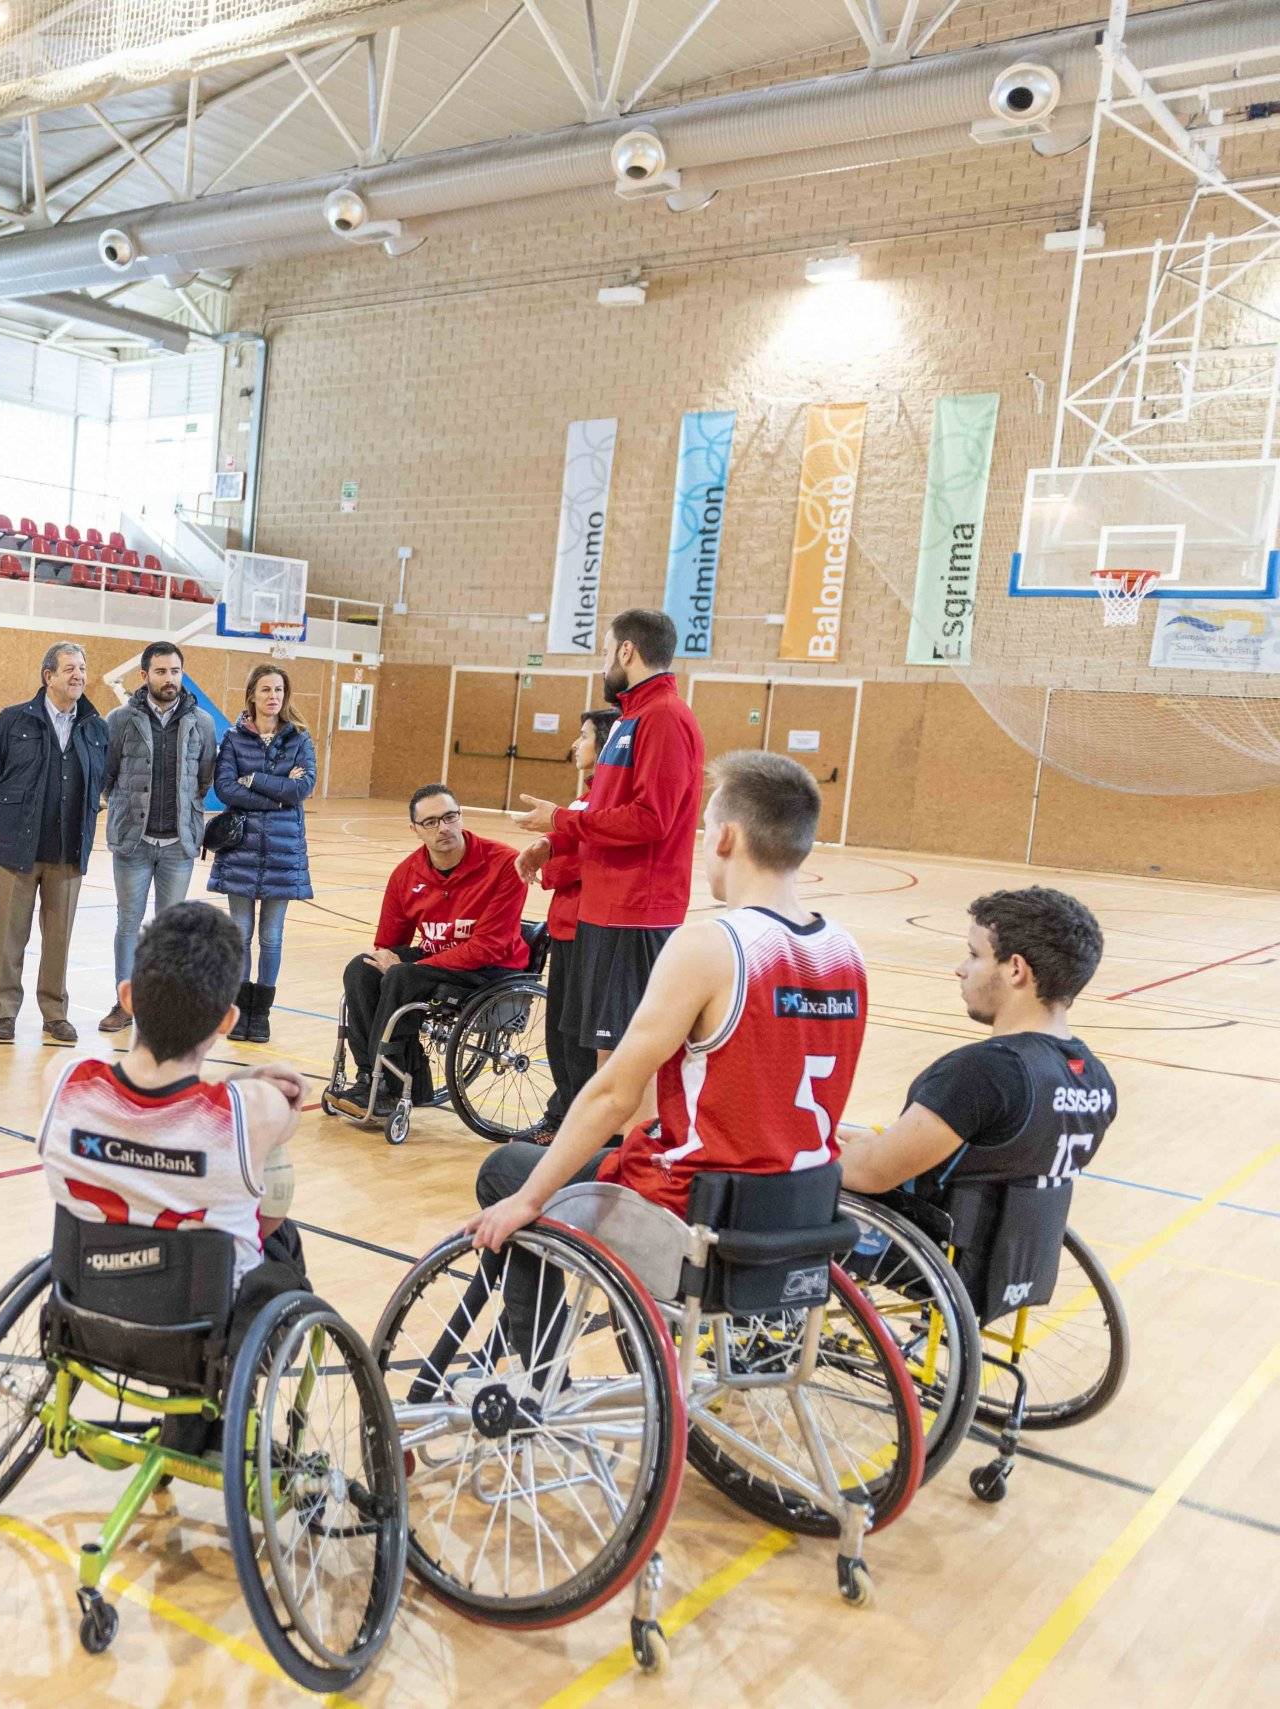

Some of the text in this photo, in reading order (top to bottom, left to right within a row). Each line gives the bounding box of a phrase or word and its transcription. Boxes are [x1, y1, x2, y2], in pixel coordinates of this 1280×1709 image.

[572, 511, 605, 650] Atletismo
[685, 486, 725, 653] Bádminton
[808, 474, 854, 656] Baloncesto
[932, 522, 976, 660] Esgrima
[104, 1141, 197, 1173] CaixaBank
[790, 1055, 837, 1171] 5
[92, 1246, 161, 1271] QUICKIE
